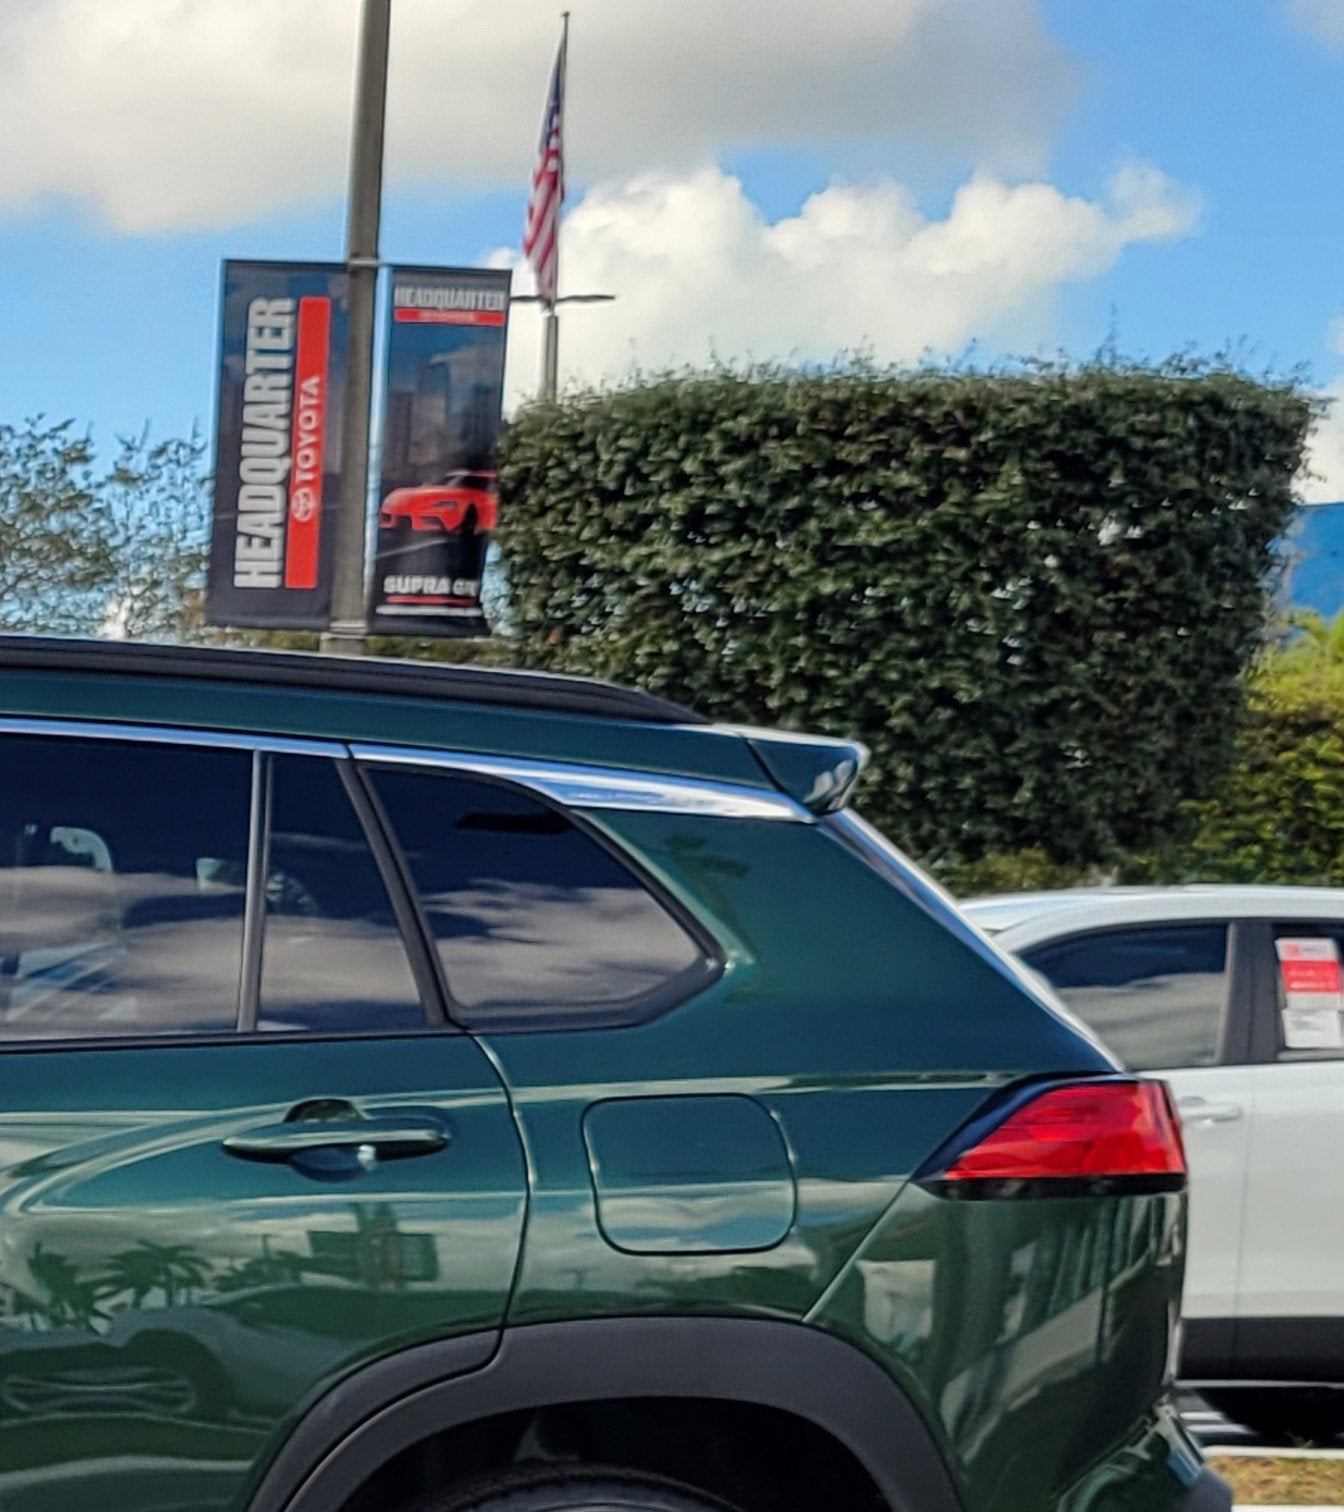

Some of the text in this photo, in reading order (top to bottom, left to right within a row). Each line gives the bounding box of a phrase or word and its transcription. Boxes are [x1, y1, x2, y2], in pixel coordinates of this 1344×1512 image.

[234, 297, 296, 589] HEADQUARTER
[295, 375, 321, 482] TOYOTA
[384, 575, 451, 595] SUPRA
